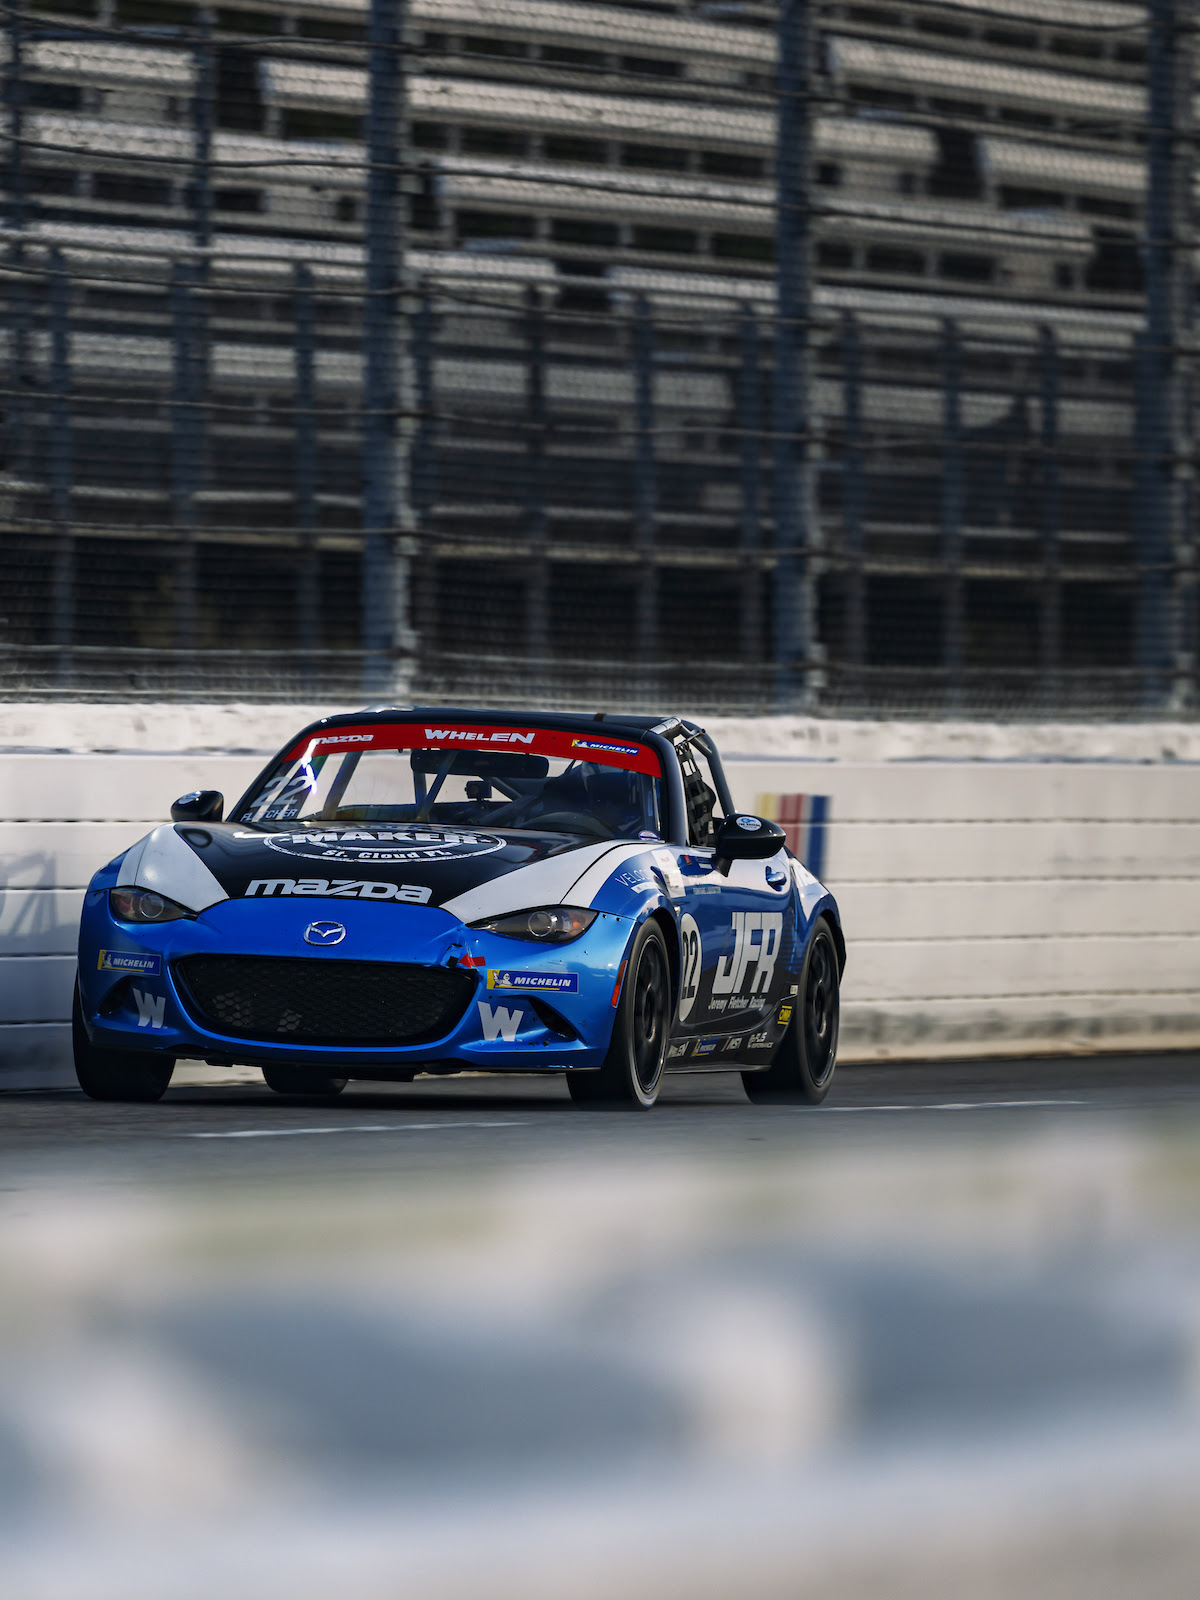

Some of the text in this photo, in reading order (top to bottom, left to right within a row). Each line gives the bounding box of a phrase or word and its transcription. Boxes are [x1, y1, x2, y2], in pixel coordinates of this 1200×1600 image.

[424, 728, 535, 744] WHELEN
[590, 743, 638, 754] MICHELIN
[250, 775, 313, 808] 22
[240, 808, 297, 821] FLTCHER
[291, 831, 478, 844] MAKER
[358, 852, 420, 860] Cloud
[712, 912, 783, 994] JFR
[113, 958, 154, 968] MICHELIN
[682, 930, 698, 1000] 22
[514, 976, 571, 987] MICHELIN
[132, 988, 166, 1028] W
[708, 997, 729, 1013] Jeremy
[728, 996, 749, 1010] Fletcher
[477, 1000, 524, 1042] W
